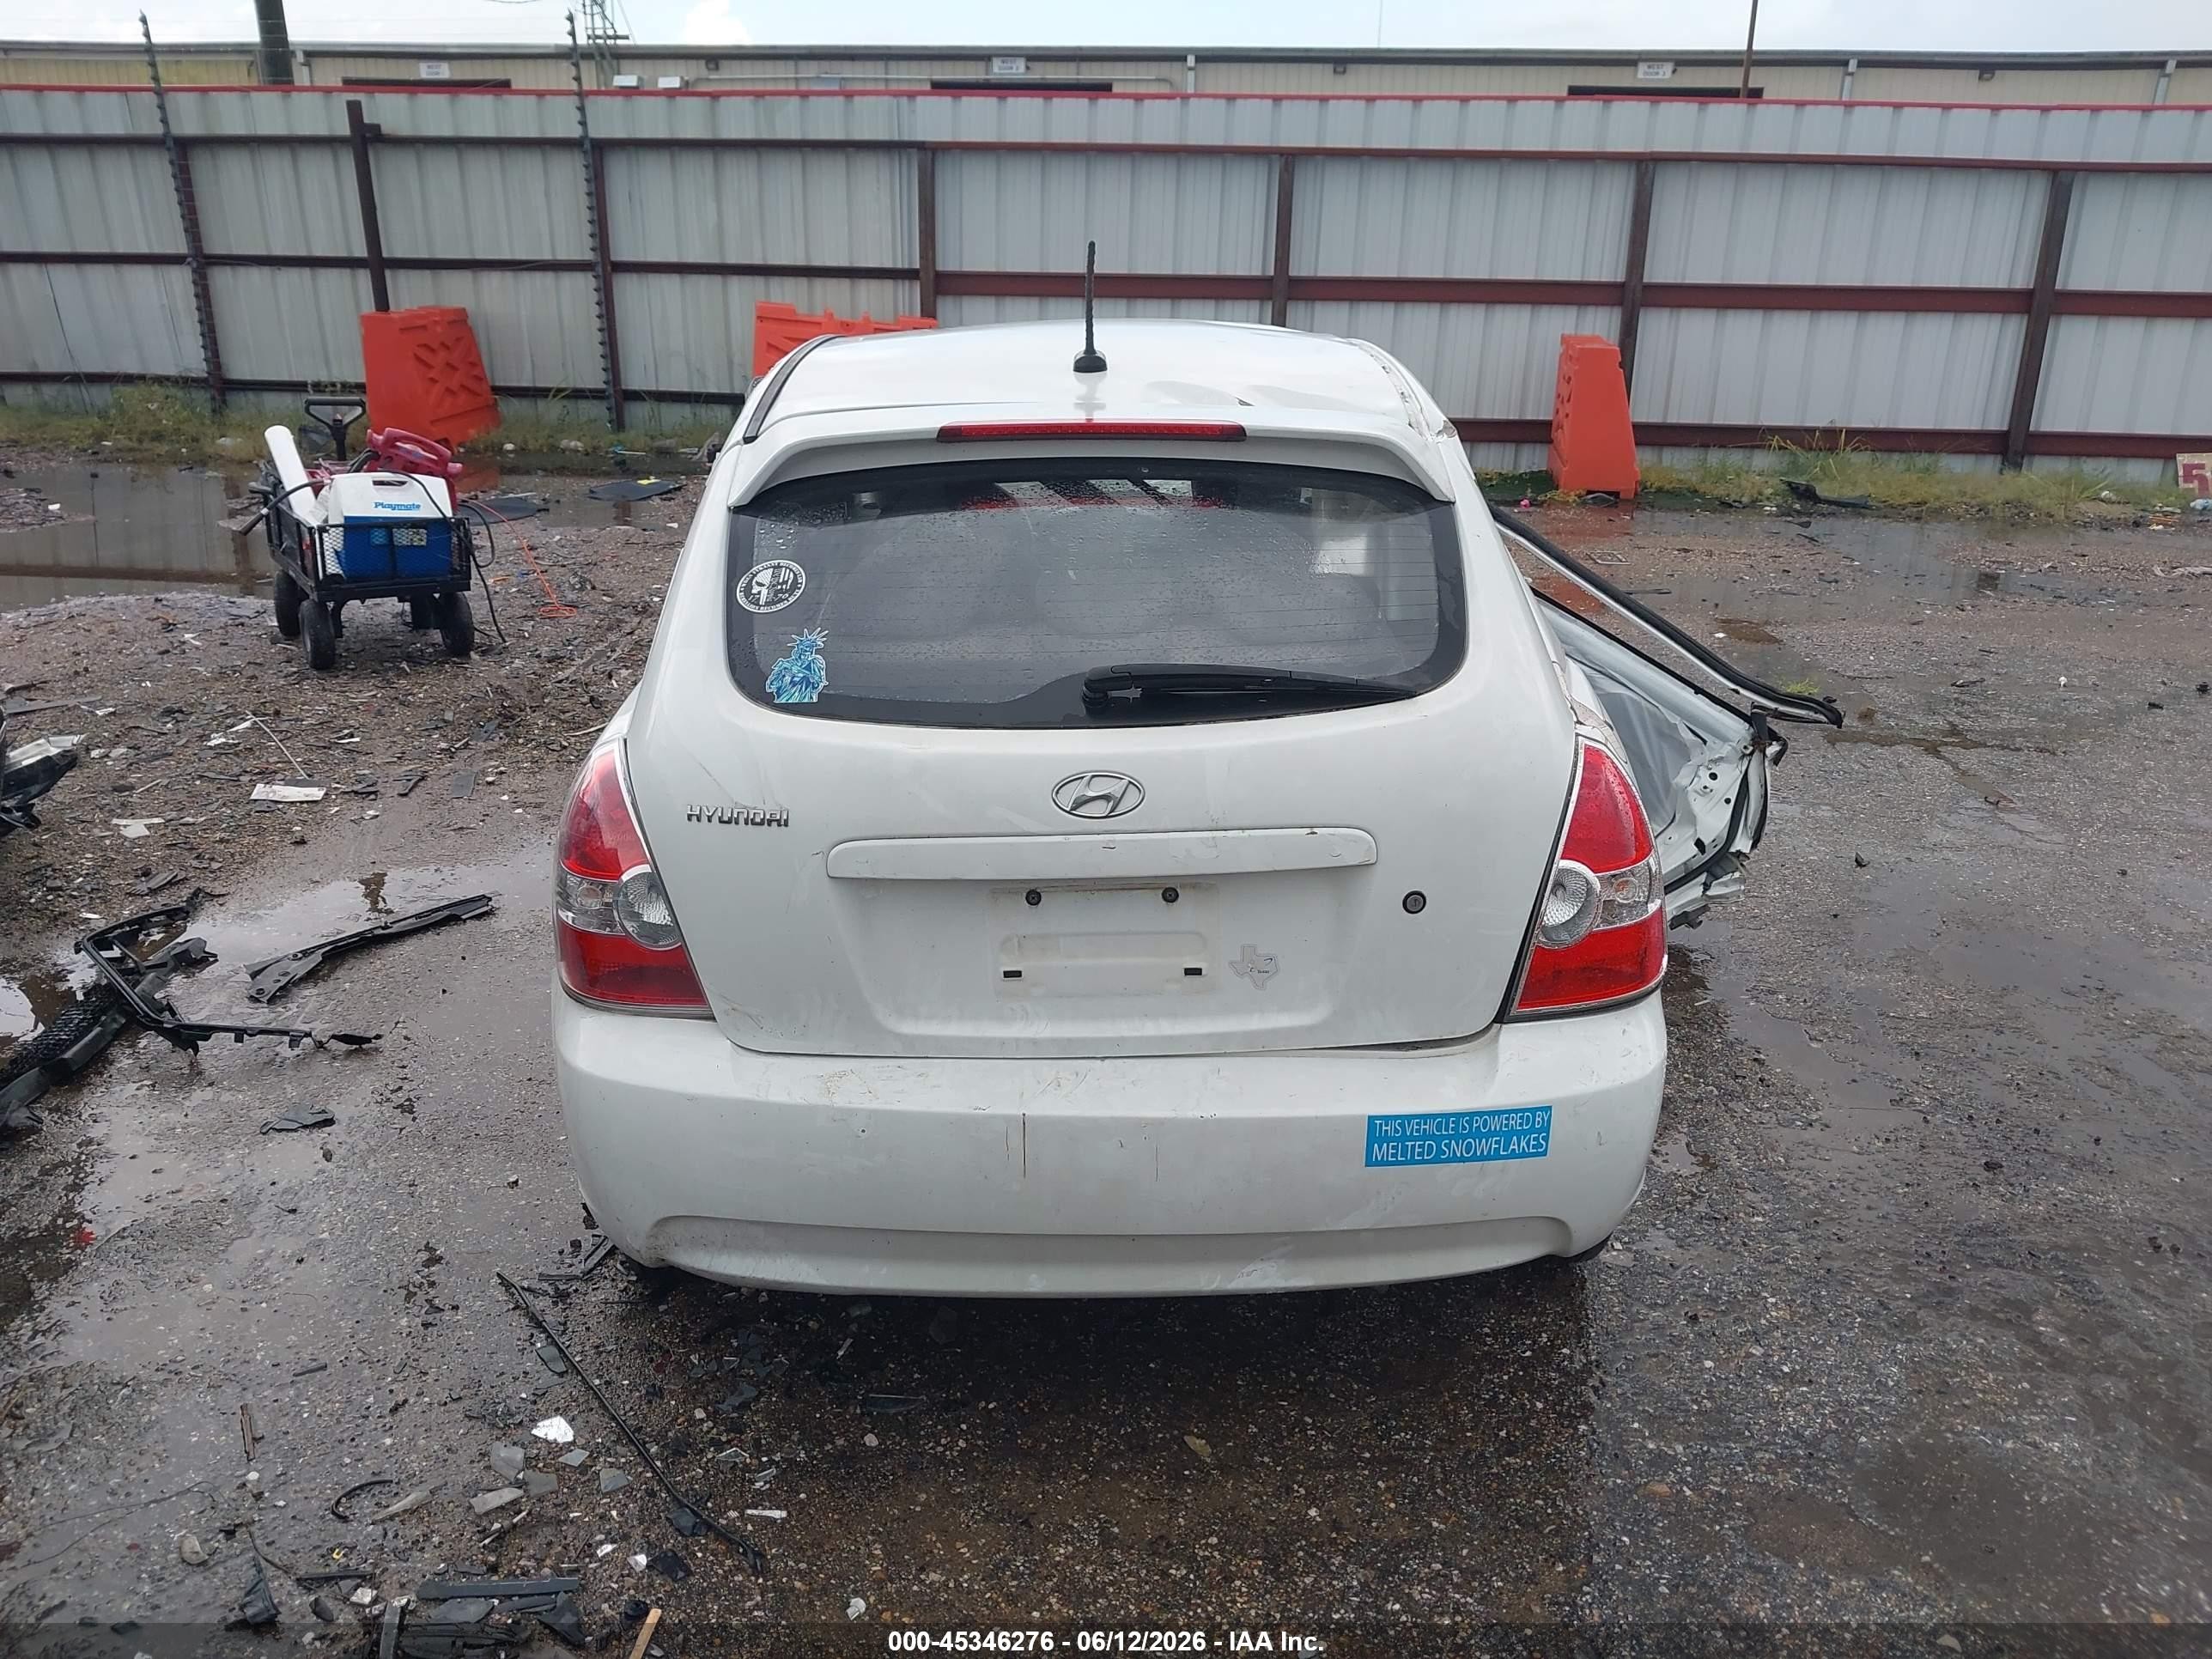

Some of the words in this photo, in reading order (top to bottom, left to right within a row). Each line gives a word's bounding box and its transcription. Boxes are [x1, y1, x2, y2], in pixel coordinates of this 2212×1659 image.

[374, 501, 421, 511] Playmate
[686, 804, 789, 827] HYUNDAI
[1374, 1120, 1402, 1138] THIS
[1405, 1117, 1456, 1136] VEHICLE
[1459, 1116, 1469, 1134] IS
[1473, 1112, 1533, 1133] POWERED
[1534, 1110, 1551, 1128] BY
[1372, 1140, 1437, 1162] MELTED
[1440, 1133, 1547, 1159] SNOWFLAKES
